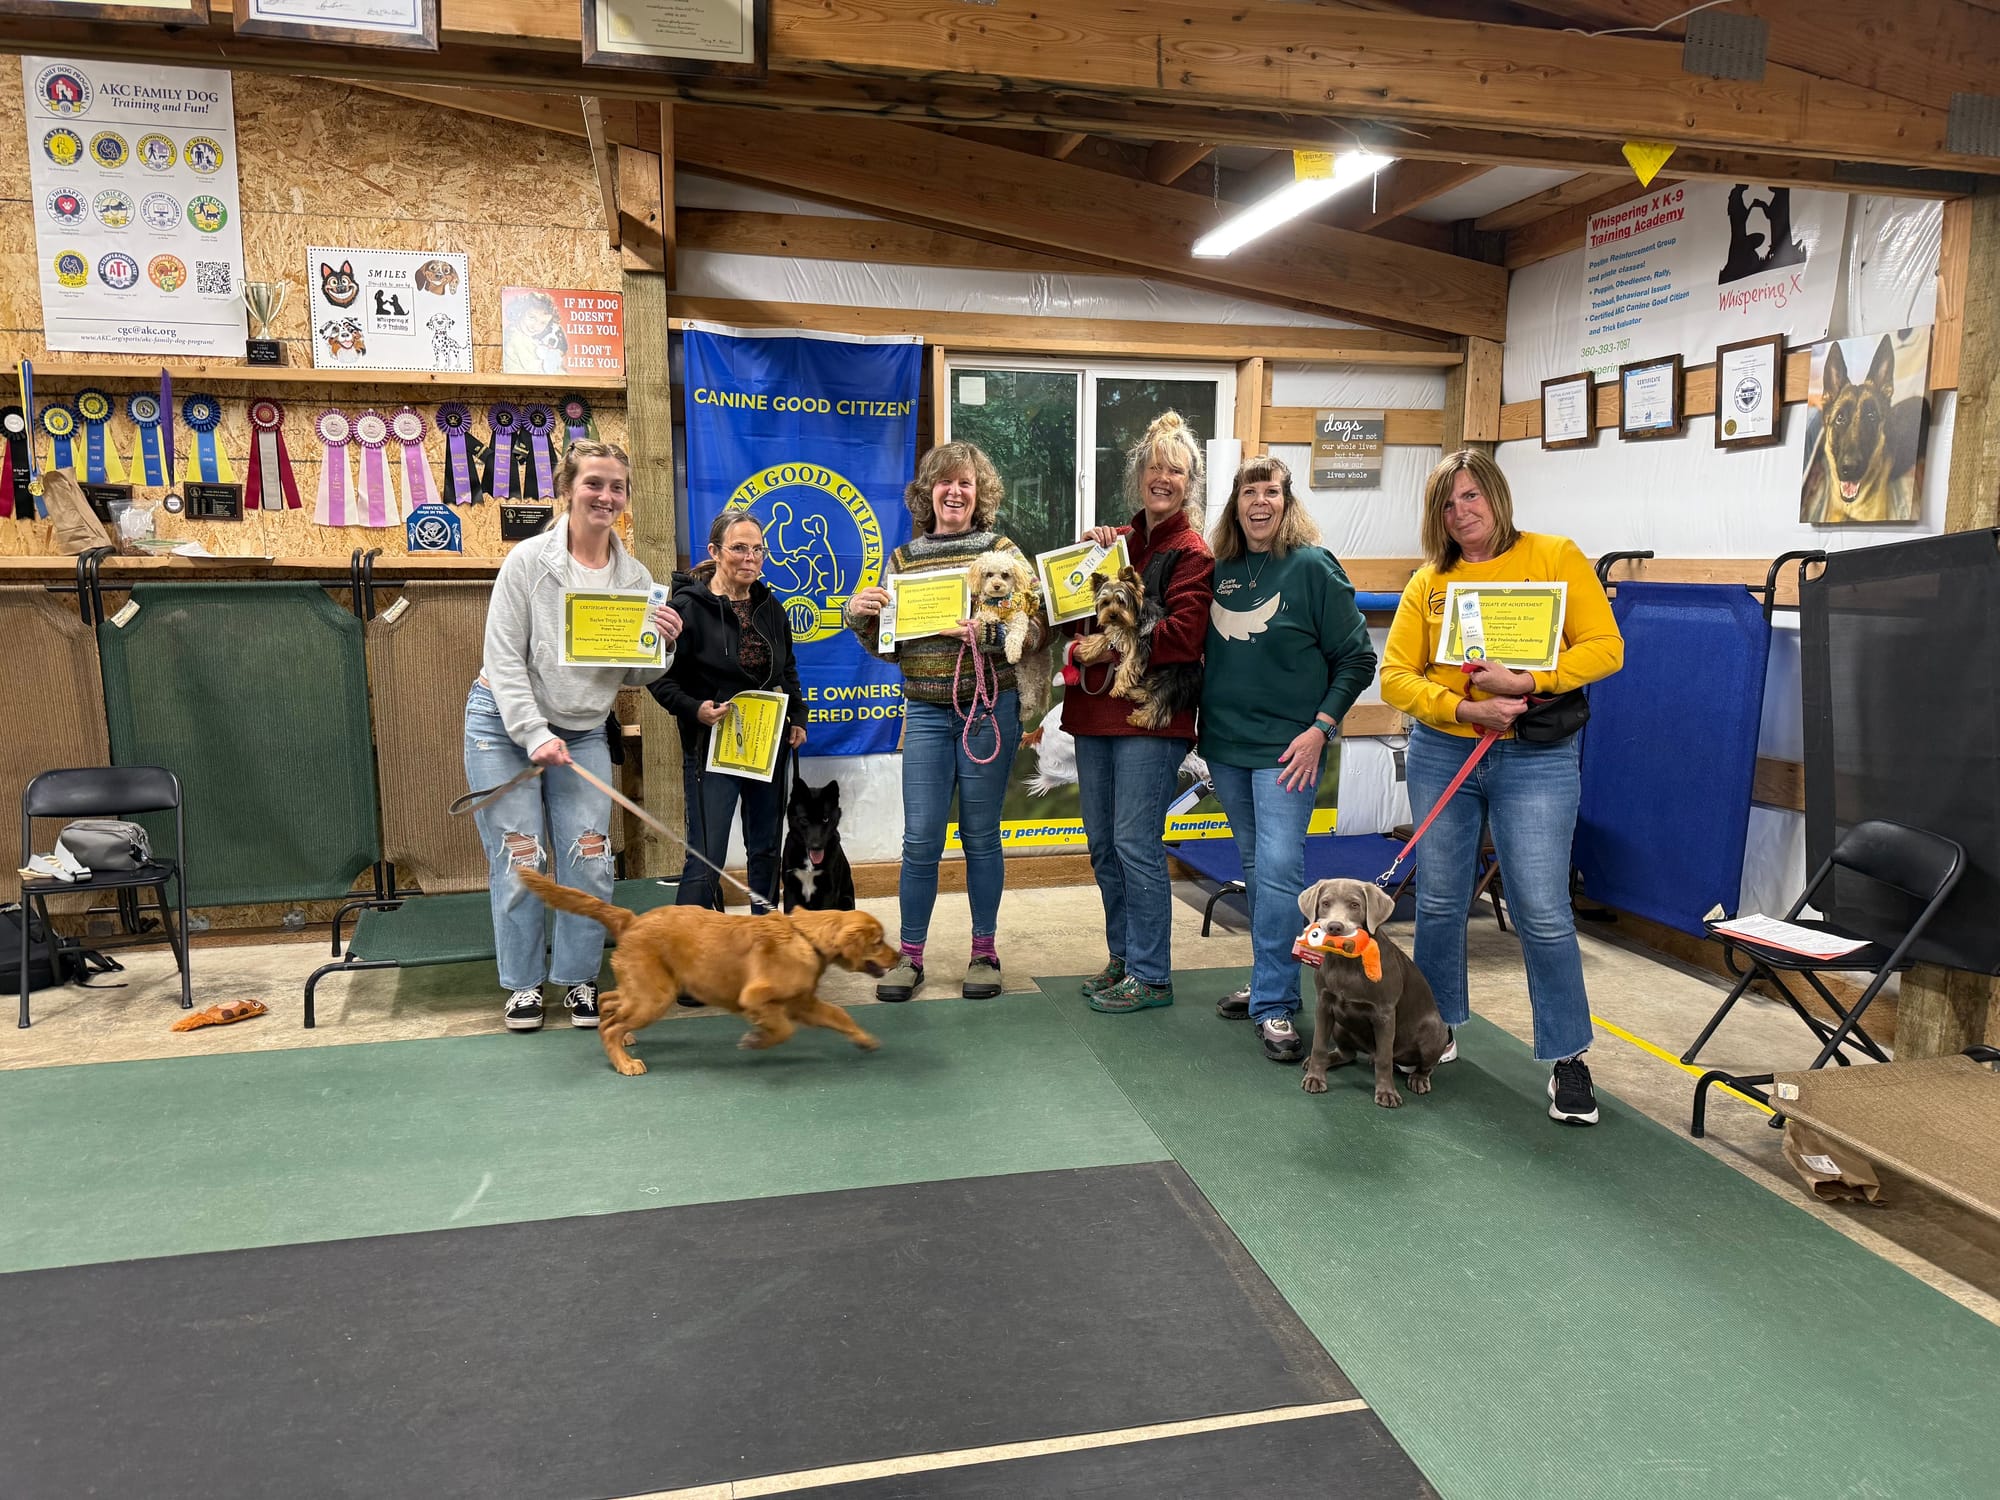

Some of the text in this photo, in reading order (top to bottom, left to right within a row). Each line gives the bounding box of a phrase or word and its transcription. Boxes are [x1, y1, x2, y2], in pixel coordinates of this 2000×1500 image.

[99, 83, 219, 103] AKC FAMILY DOG
[111, 96, 209, 114] Training and Fun!
[1591, 189, 1684, 232] Whispering X K-9
[1590, 207, 1685, 247] Training Academy
[1610, 243, 1656, 262] Reinforcement
[1657, 238, 1676, 248] Group
[368, 269, 407, 278] SMILES
[1588, 274, 1599, 283] and
[1615, 275, 1652, 288] Obedience,
[1654, 269, 1672, 279] Rally,
[1616, 288, 1650, 302] Behavioral
[1651, 283, 1672, 294] Issues
[1719, 272, 1802, 314] Whispering X
[564, 298, 618, 310] IF MY DOG
[1589, 309, 1614, 321] Certified
[1626, 301, 1650, 312] Canine
[1652, 296, 1668, 307] Good
[1670, 291, 1690, 302] Citizen
[571, 312, 613, 322] DOESN'T
[117, 326, 177, 337] cgc@akc.org
[566, 325, 619, 336] LIKE YOU,
[1588, 328, 1600, 336] and
[1602, 323, 1616, 333] Trick
[574, 344, 611, 355] I DON'T
[1580, 338, 1631, 358] 360-393-7097
[567, 358, 620, 368] LIKE YOU.
[693, 388, 768, 410] CANINE
[772, 396, 831, 414] GOOD
[1324, 413, 1363, 442] dogs
[1348, 452, 1364, 460] they
[1327, 471, 1368, 479] lives whole
[763, 466, 880, 571] GOOD CITIZEN
[1015, 826, 1085, 839] performa
